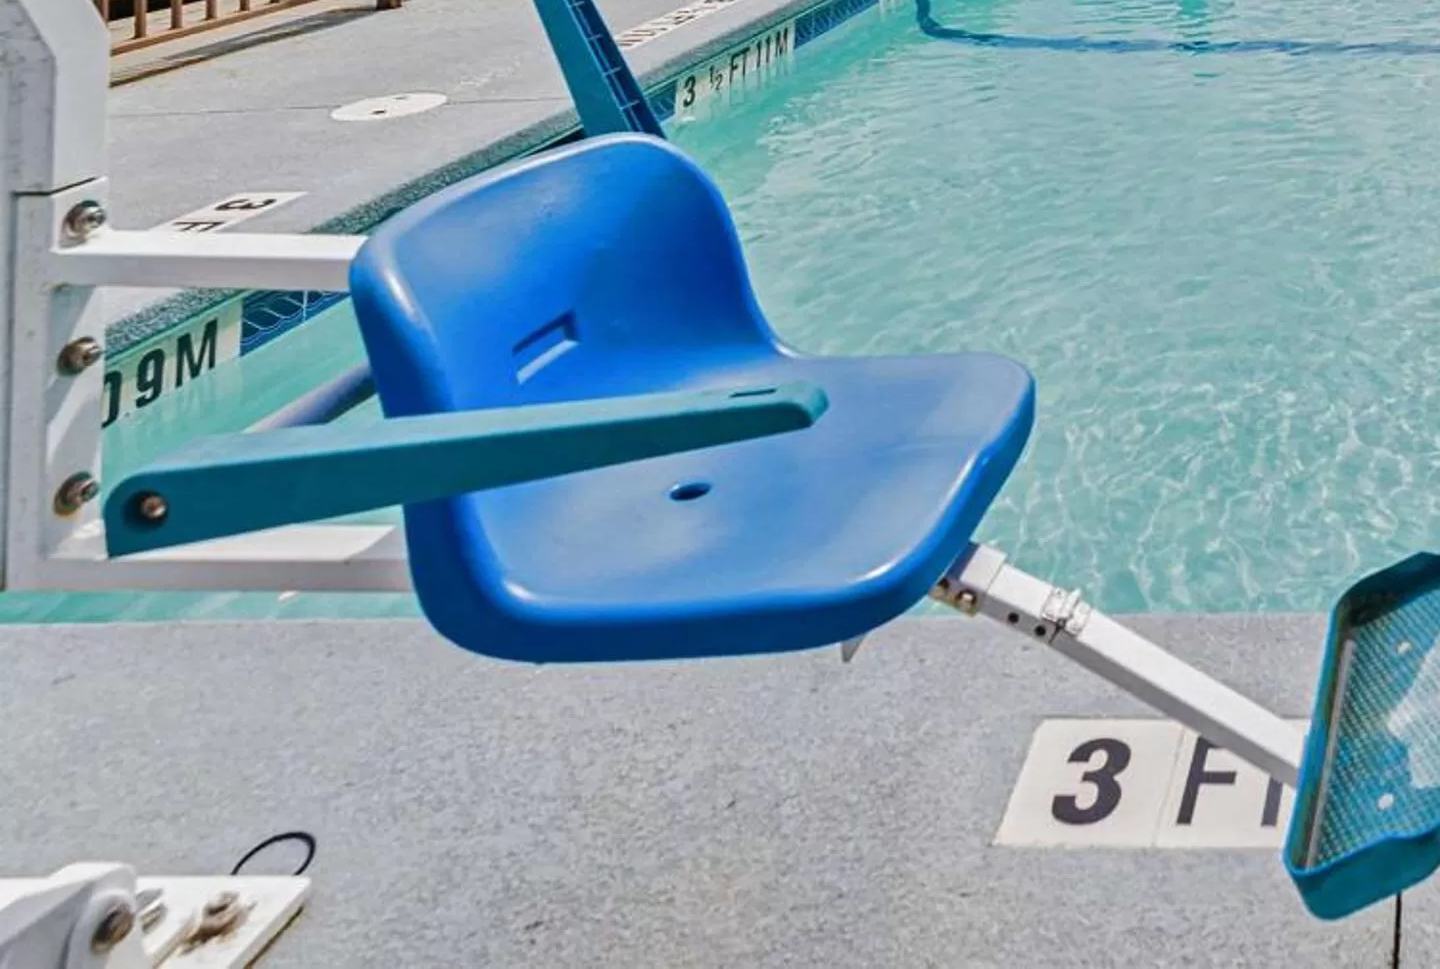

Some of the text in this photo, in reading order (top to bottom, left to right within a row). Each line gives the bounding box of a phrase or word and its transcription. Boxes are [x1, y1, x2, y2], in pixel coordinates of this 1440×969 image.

[683, 75, 697, 107] 3
[730, 46, 750, 85] FT
[215, 198, 279, 212] 3
[1051, 737, 1132, 826] 3
